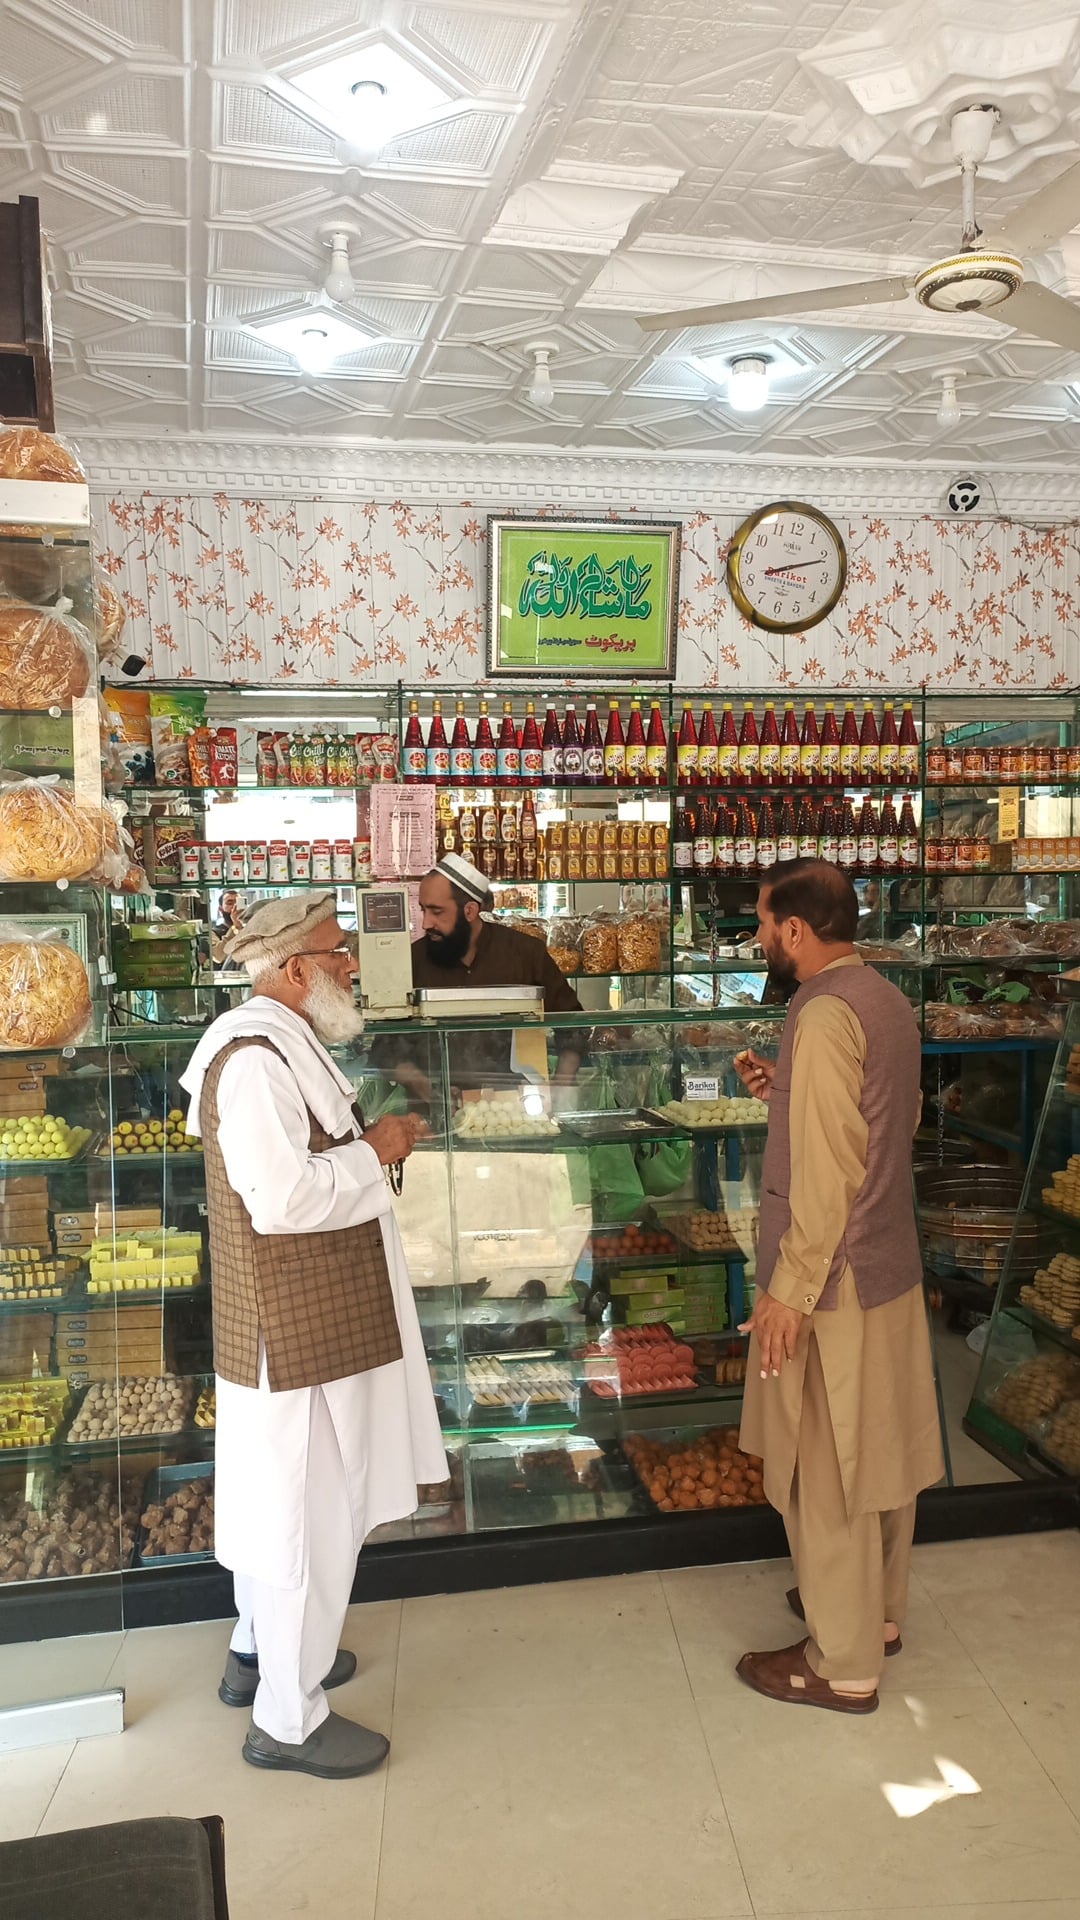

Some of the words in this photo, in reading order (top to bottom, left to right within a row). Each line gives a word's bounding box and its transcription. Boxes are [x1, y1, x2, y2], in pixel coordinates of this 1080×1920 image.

[772, 523, 785, 537] 11
[790, 522, 805, 536] 12
[755, 534, 768, 548] 10
[809, 532, 816, 545] 1
[744, 551, 754, 565] 9
[820, 550, 828, 563] 2
[745, 573, 756, 586] 8
[763, 566, 807, 584] Barikot
[820, 571, 829, 585] 3
[757, 591, 767, 604] 7
[808, 590, 817, 603] 4
[773, 601, 783, 614] 6
[791, 601, 801, 614] 5
[687, 1081, 716, 1090] Barikot
